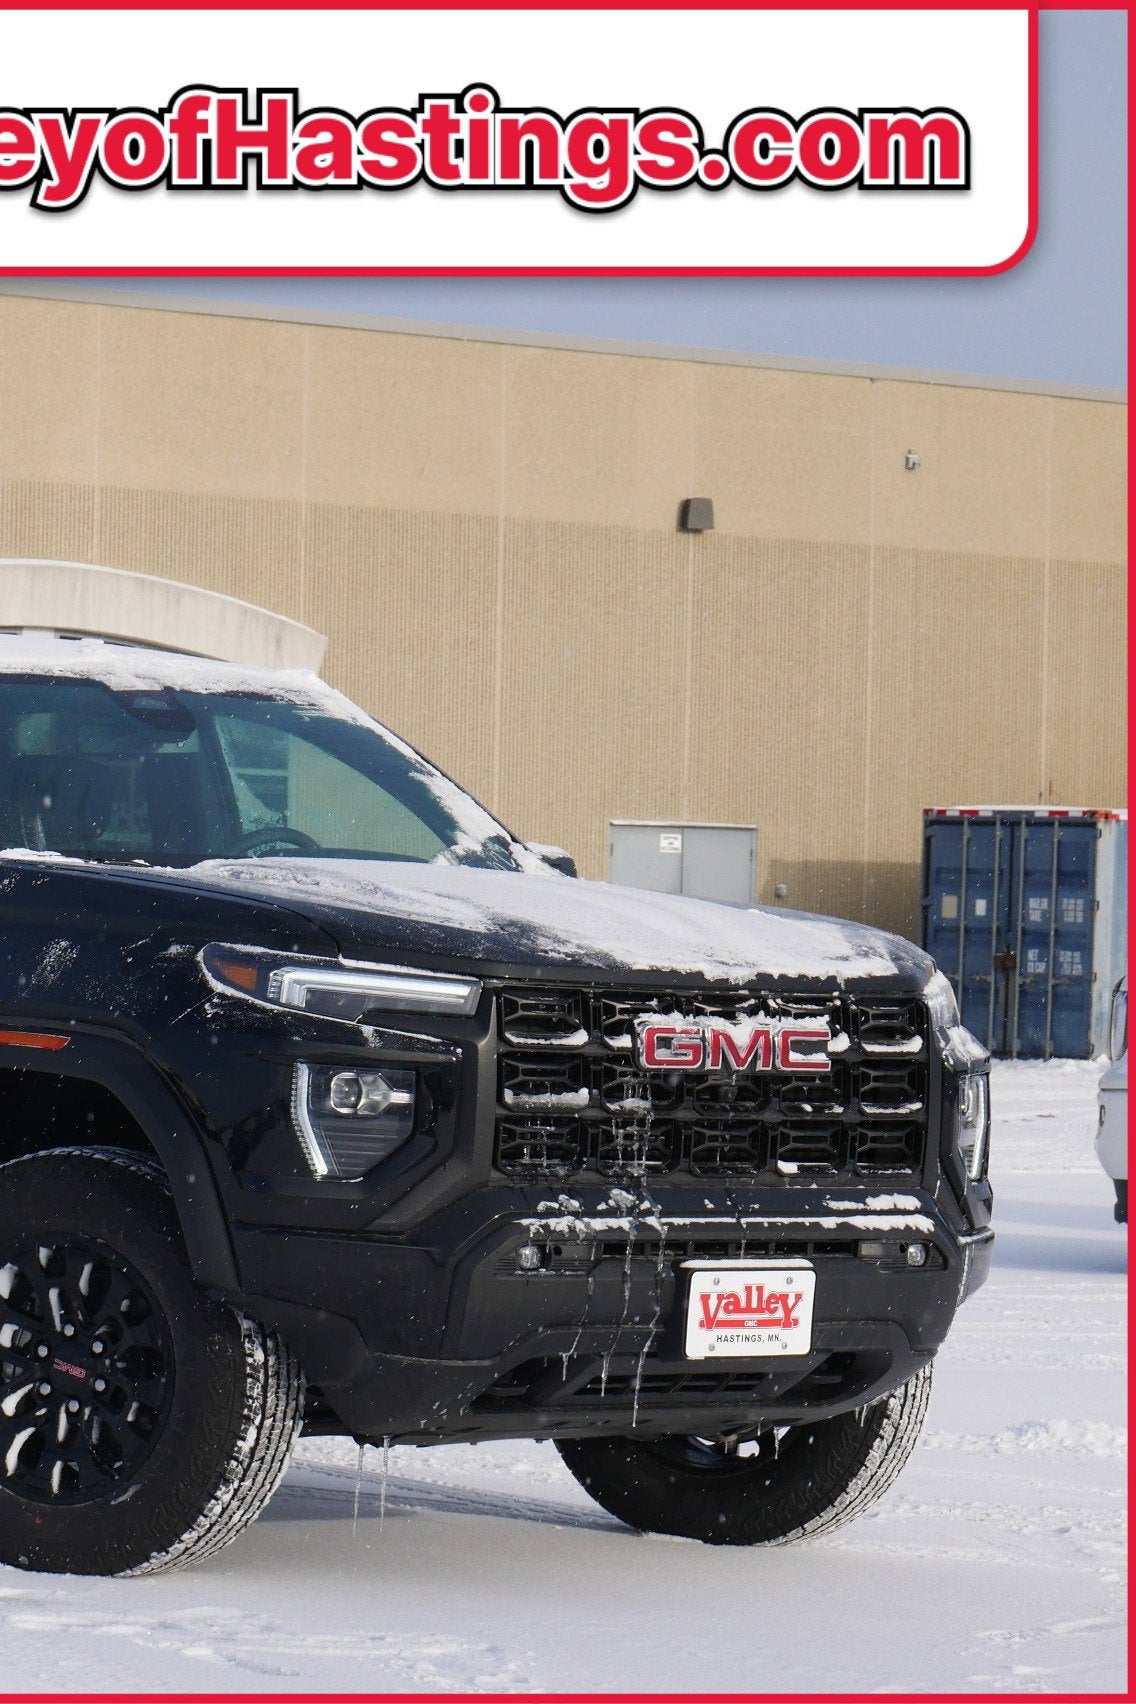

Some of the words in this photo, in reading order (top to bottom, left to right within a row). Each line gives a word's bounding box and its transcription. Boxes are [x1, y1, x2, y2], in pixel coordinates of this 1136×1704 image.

[640, 1024, 832, 1072] GMC
[699, 1284, 802, 1330] Valley
[716, 1333, 765, 1344] HASTINGS,
[767, 1333, 782, 1342] MN.
